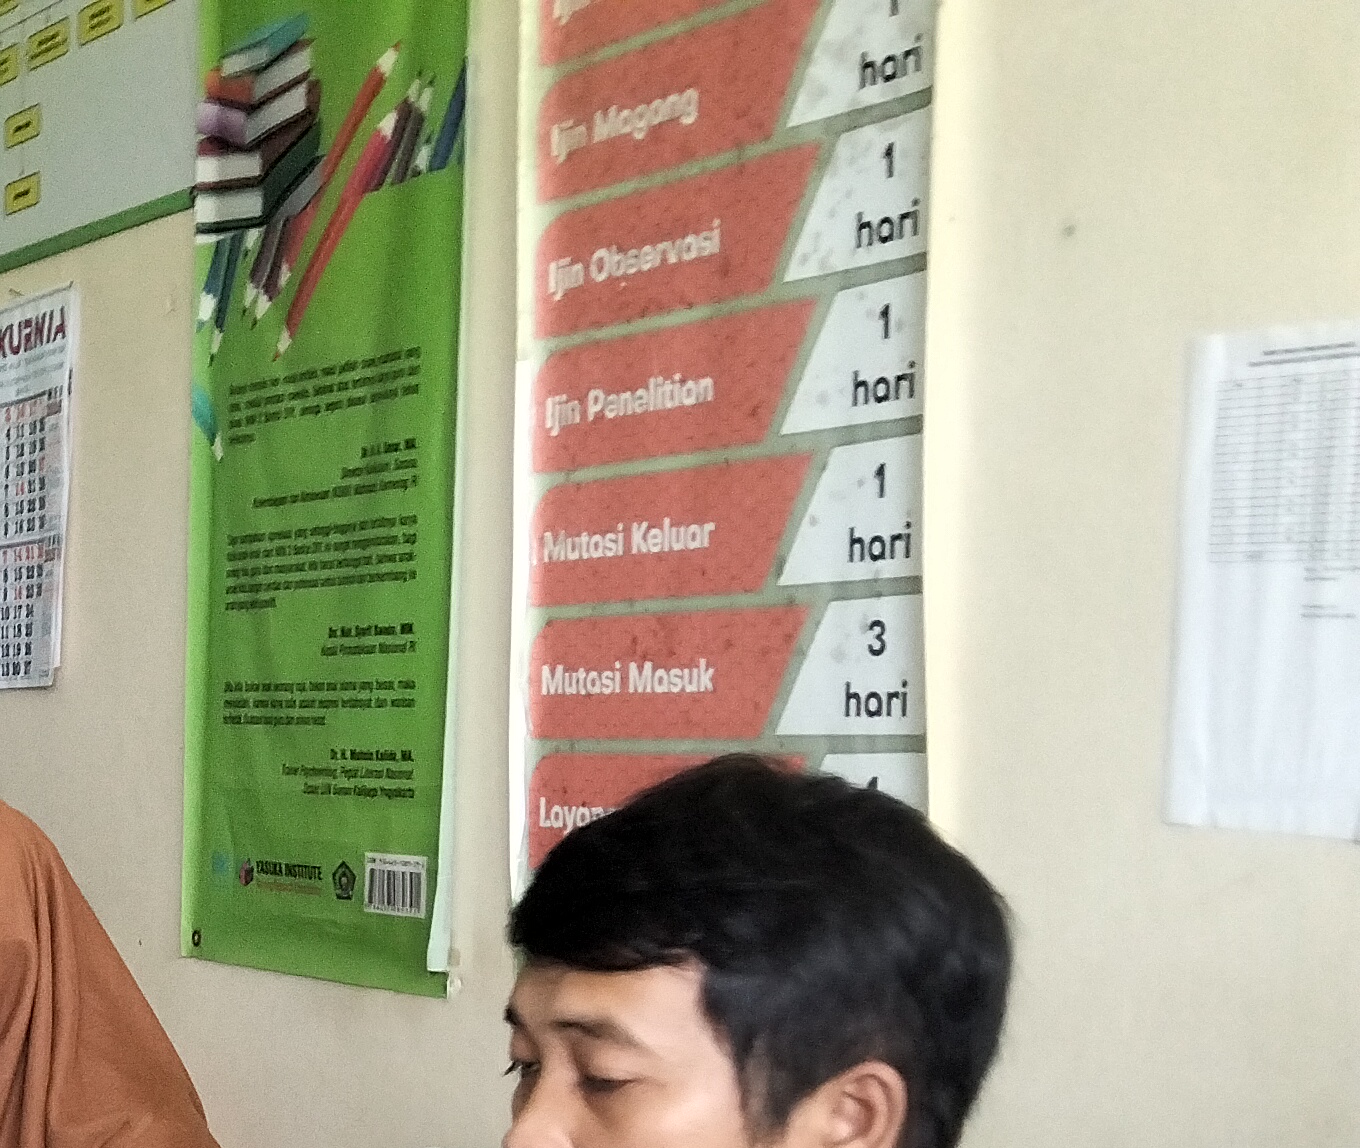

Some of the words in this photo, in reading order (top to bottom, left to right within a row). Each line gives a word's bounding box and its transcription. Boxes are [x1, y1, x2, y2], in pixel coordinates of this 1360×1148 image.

[858, 32, 923, 90] hari
[592, 87, 700, 142] Magang
[882, 142, 896, 178] 1
[855, 197, 921, 249] hari
[548, 257, 584, 301] Ijin
[589, 217, 722, 283] Observasi
[878, 302, 891, 339] 1
[545, 393, 581, 437] Ijin
[587, 372, 715, 422] Penelitian
[851, 359, 917, 408] hari
[873, 462, 887, 498] 1
[543, 522, 625, 563] Mutasi
[631, 517, 716, 555] Keluar
[847, 521, 912, 564] hari
[867, 619, 887, 657] 3
[541, 660, 622, 695] Mutasi
[628, 657, 716, 694] Masuk
[844, 678, 909, 718] hari
